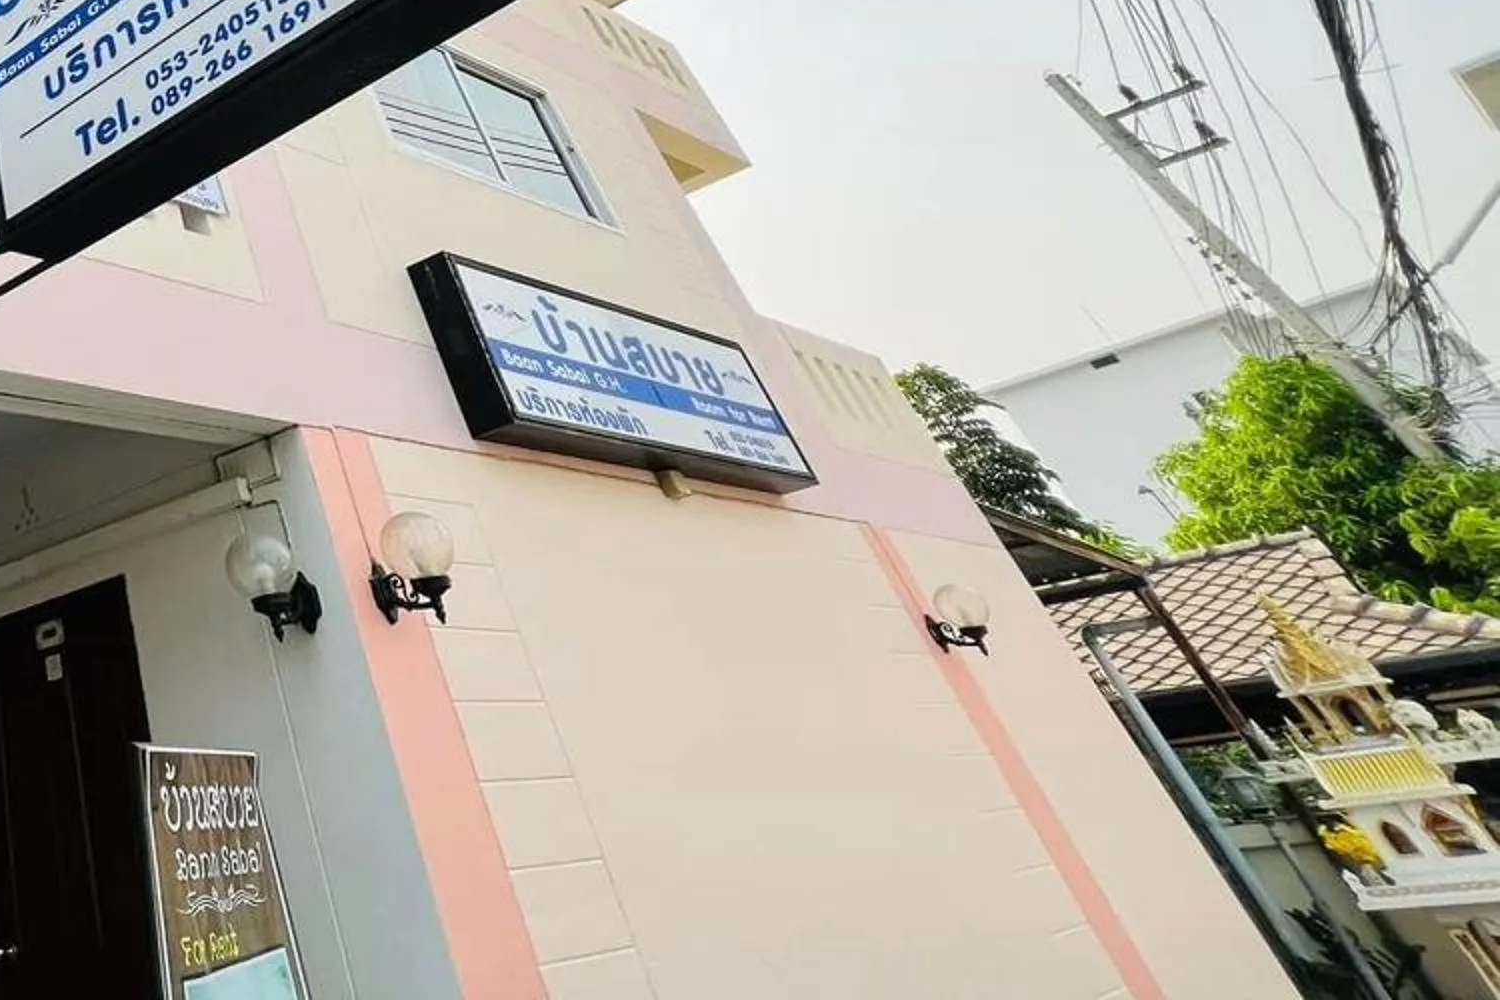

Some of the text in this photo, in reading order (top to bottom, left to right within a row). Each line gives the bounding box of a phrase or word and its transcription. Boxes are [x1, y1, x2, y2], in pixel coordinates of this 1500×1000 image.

[39, 13, 82, 52] Sabai
[75, 97, 141, 156] Tel.
[151, 39, 253, 115] 089-266
[502, 348, 543, 373] Baan
[531, 295, 726, 395] บ้านสบาย
[515, 385, 649, 435] บริการห้องพัก
[160, 761, 259, 832] บ้านสบาย
